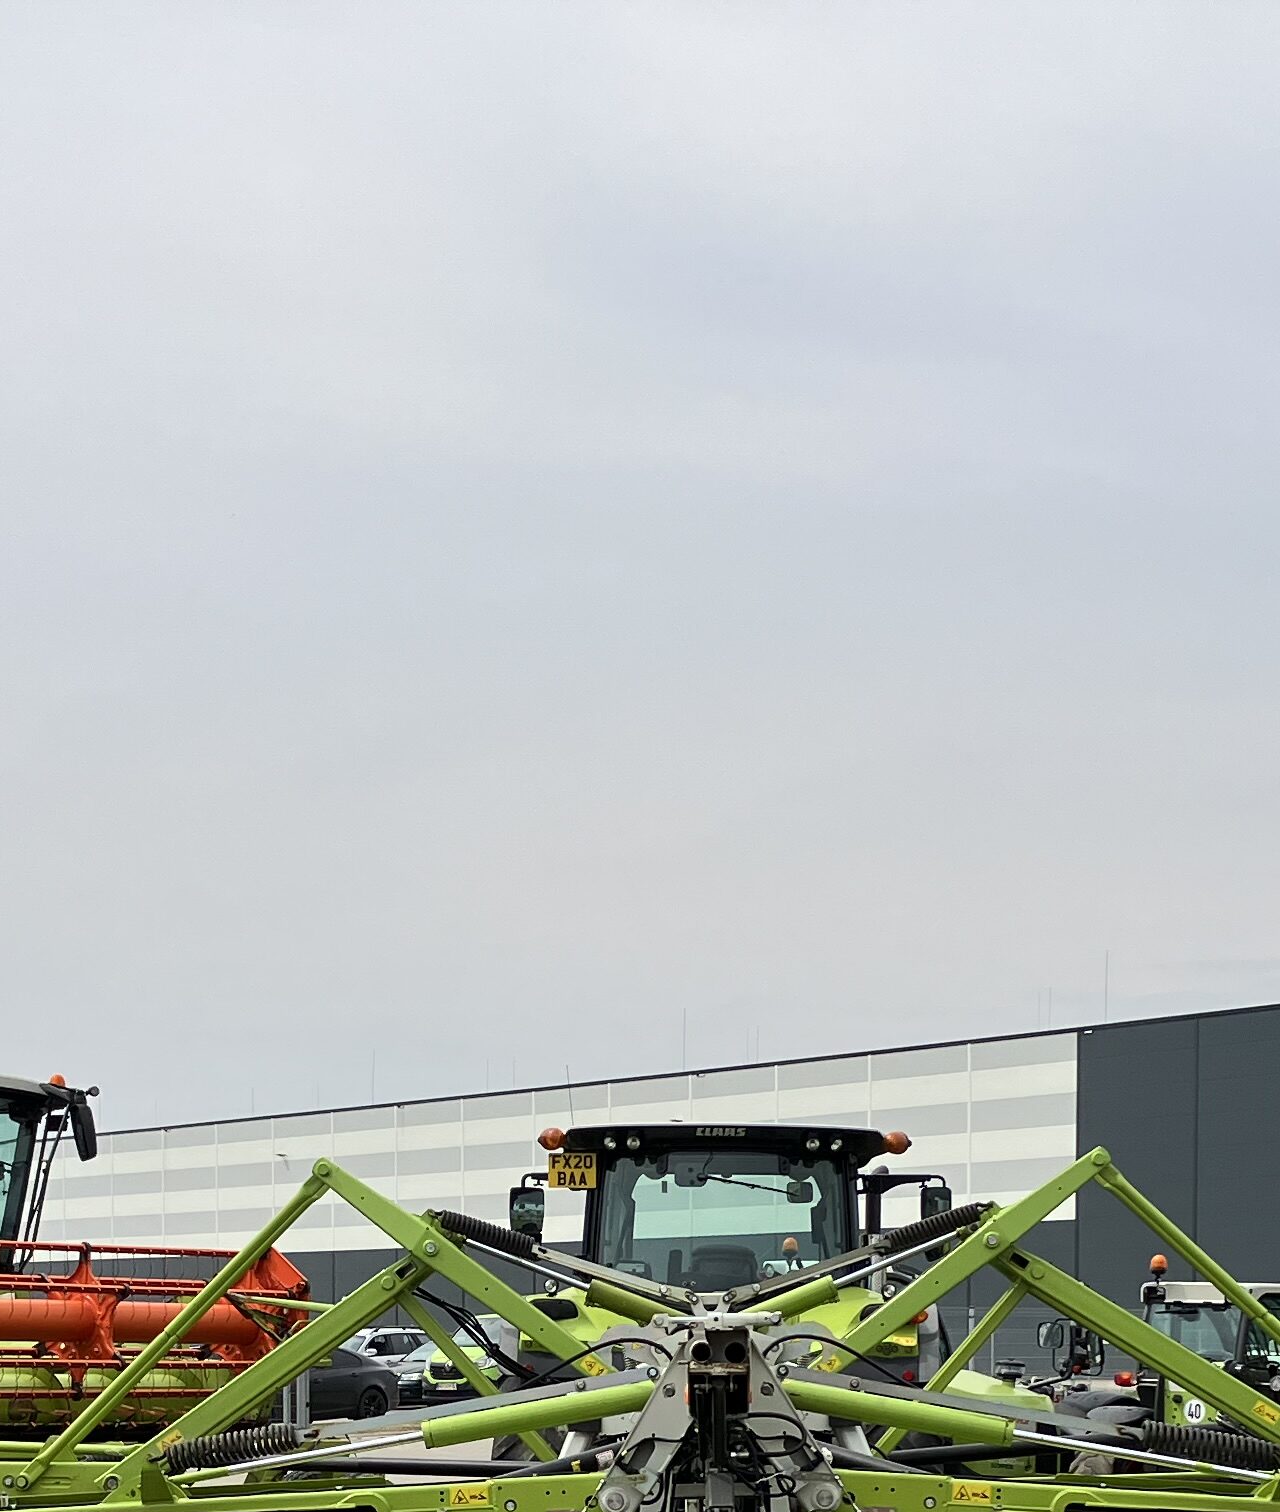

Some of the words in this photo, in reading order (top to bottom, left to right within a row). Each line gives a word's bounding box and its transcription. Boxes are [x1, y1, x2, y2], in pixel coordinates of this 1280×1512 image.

[695, 1127, 747, 1137] CLAAS
[551, 1154, 593, 1169] FX20
[557, 1171, 588, 1186] BAA
[1187, 1403, 1201, 1419] 40
